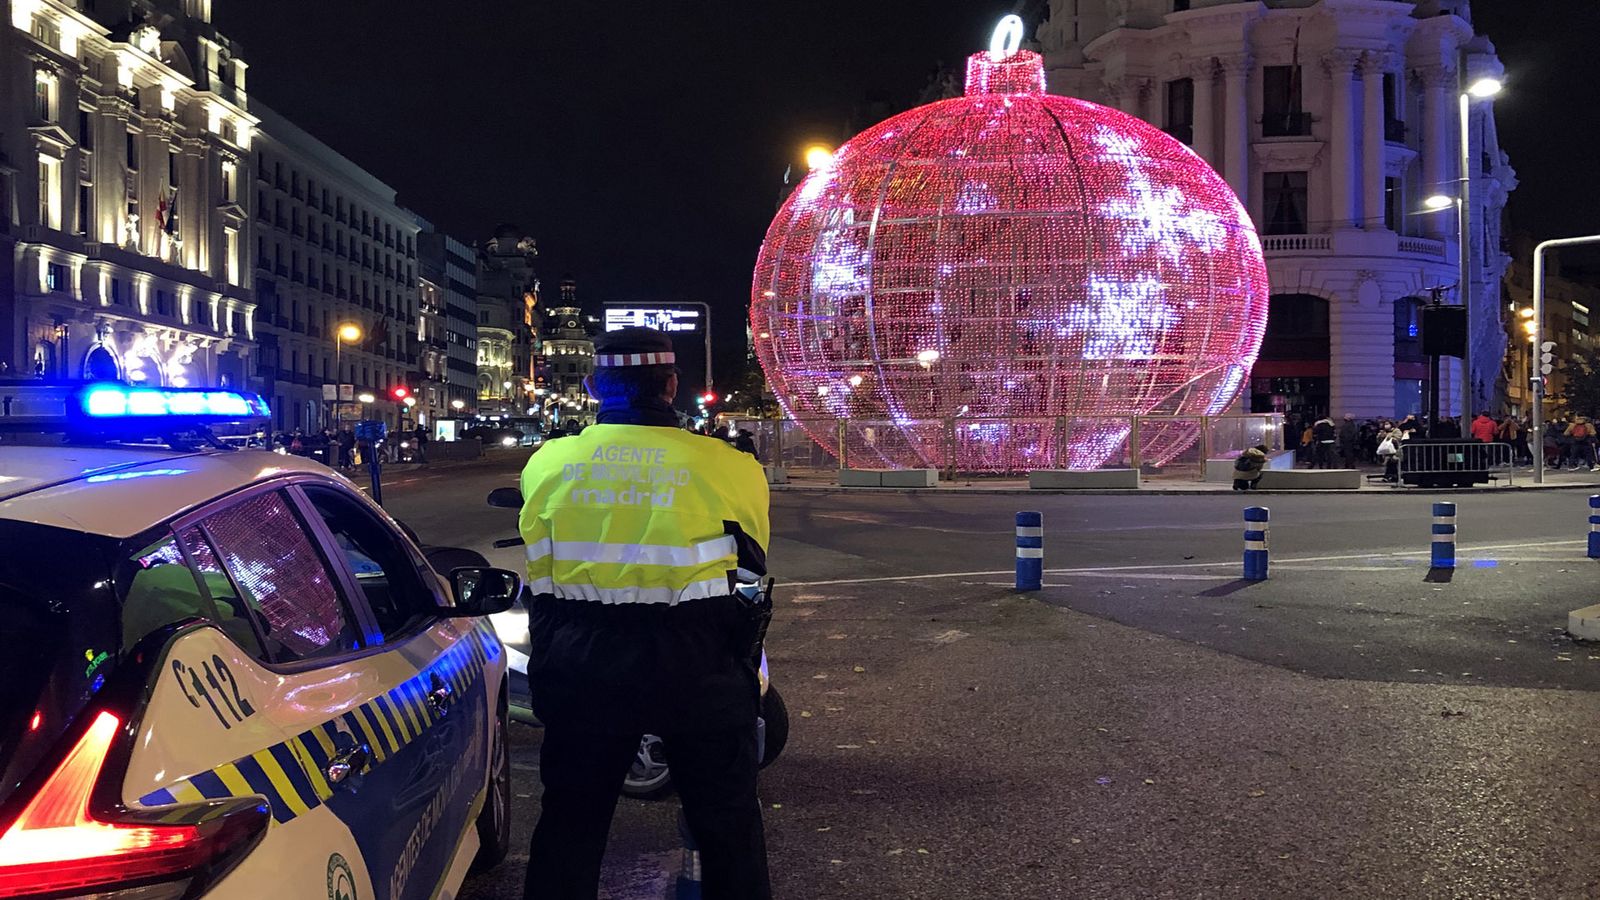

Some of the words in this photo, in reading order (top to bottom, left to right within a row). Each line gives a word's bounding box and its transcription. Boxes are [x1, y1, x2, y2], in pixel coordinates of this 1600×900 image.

[591, 444, 668, 465] AGENTE
[563, 463, 586, 481] DE
[591, 464, 691, 487] MOVILIDAD
[572, 484, 676, 508] madrid
